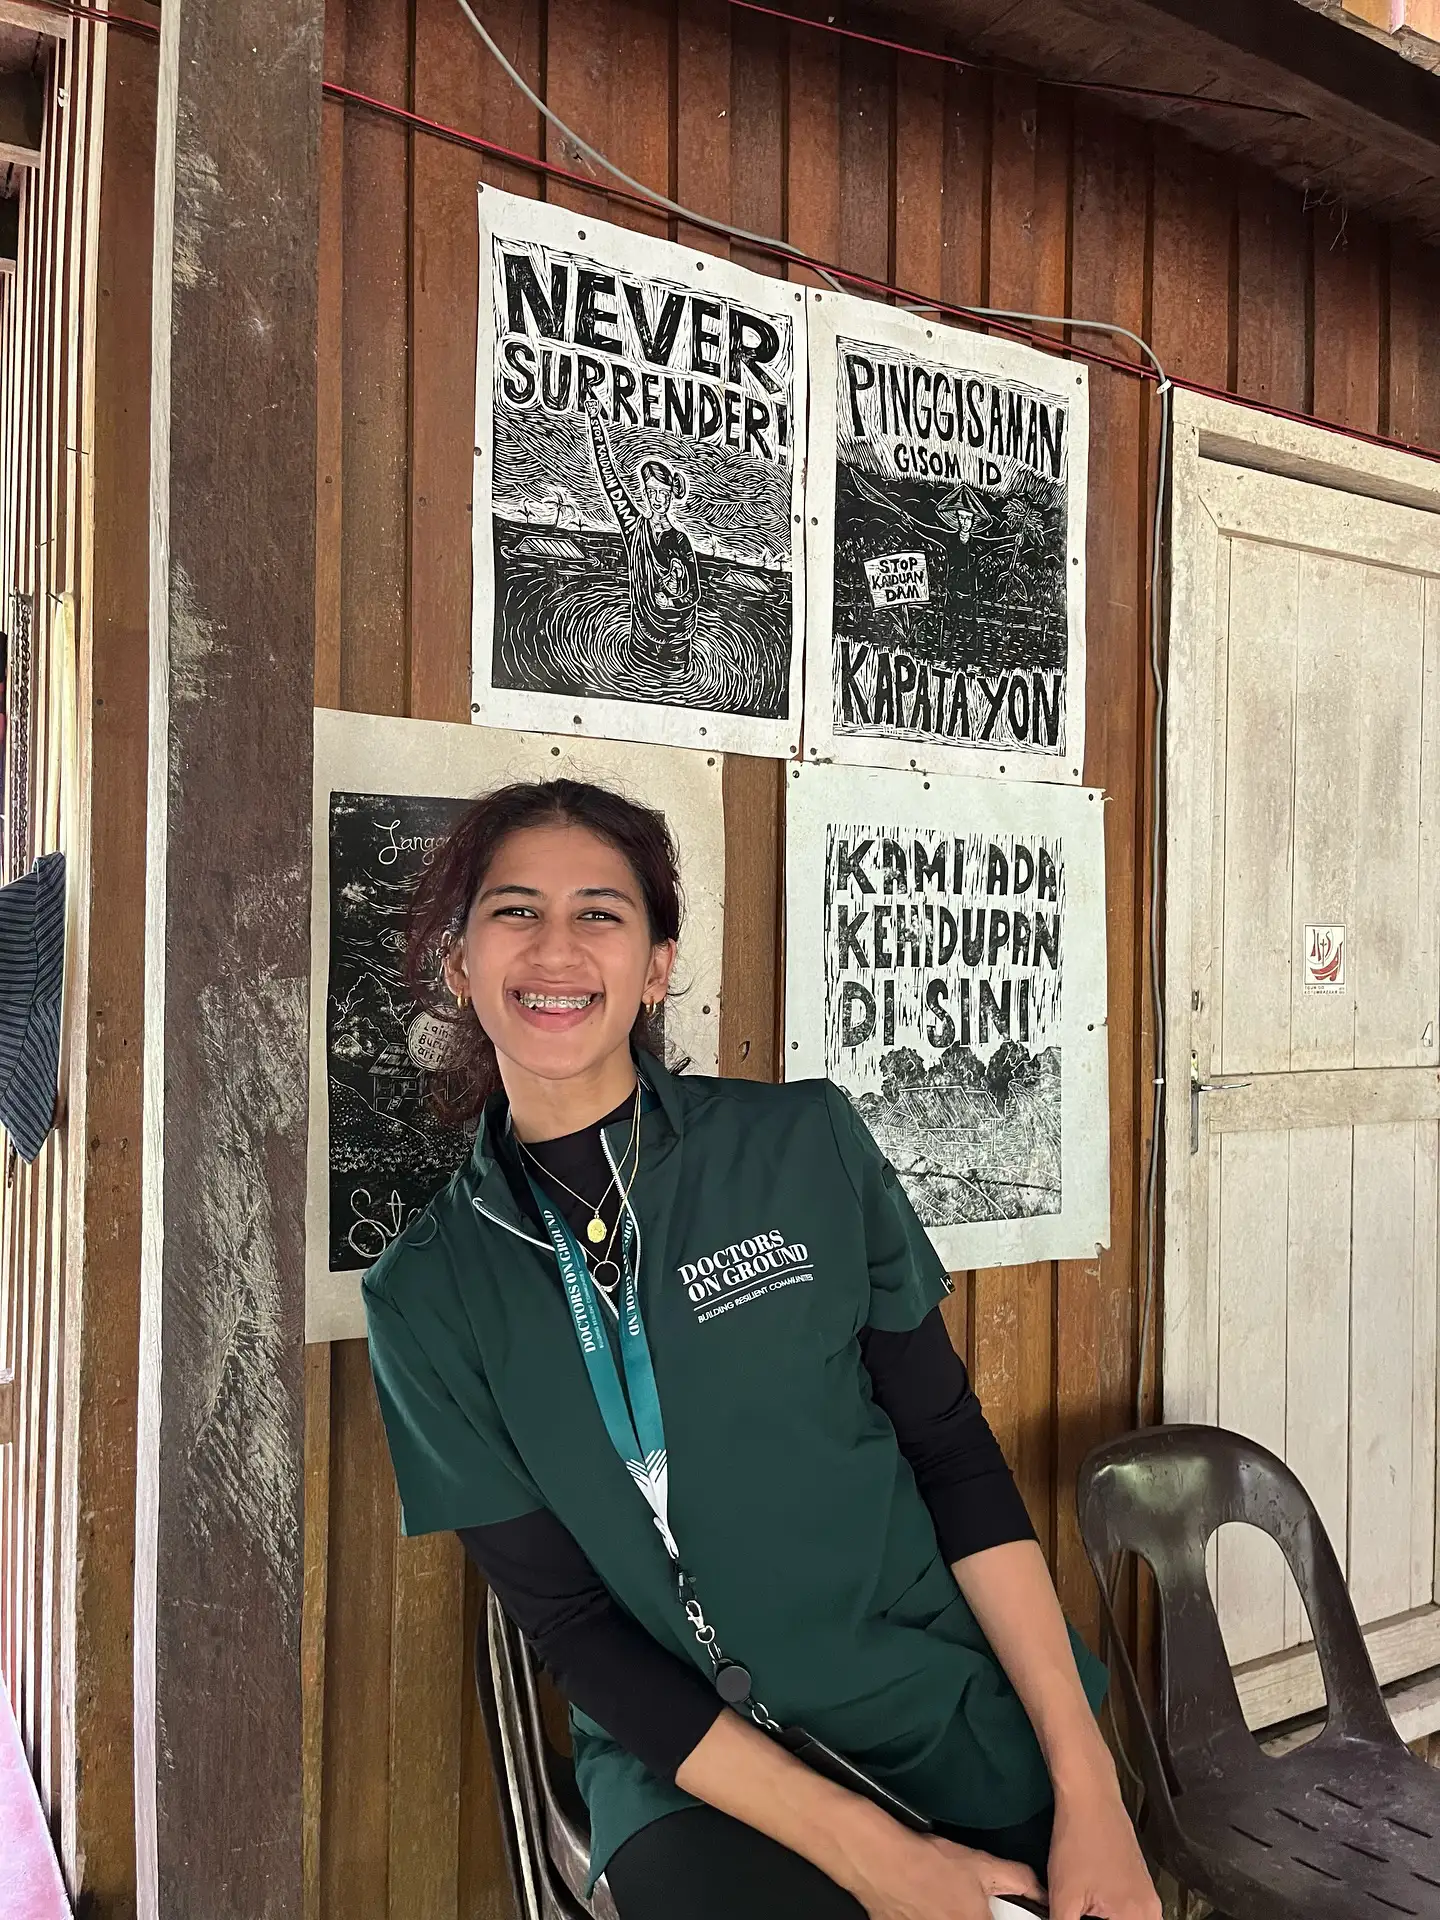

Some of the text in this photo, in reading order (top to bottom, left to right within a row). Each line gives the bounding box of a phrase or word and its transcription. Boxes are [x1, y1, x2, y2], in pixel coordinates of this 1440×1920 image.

[503, 253, 782, 394] NEVER
[504, 341, 789, 466] SURRENDER!
[591, 419, 603, 442] STOP
[845, 354, 1065, 479] PINGGISAMAN
[596, 444, 619, 489] KAIDUAN
[893, 443, 1002, 486] GISOM ID
[880, 557, 918, 574] STOP
[885, 585, 921, 603] DAM
[840, 641, 1063, 746] KAPATAYON
[837, 838, 1057, 902] KAMI ADA
[837, 904, 1061, 970] KEHIDUPAN
[842, 978, 1030, 1049] DI SINI
[562, 1263, 577, 1284] ON
[677, 1229, 785, 1285] DOCTORS
[688, 1243, 809, 1302] ON GROUND
[568, 1283, 596, 1353] DOCTORS
[697, 1301, 735, 1324] BUILDING
[734, 1286, 769, 1306] RESILIENT
